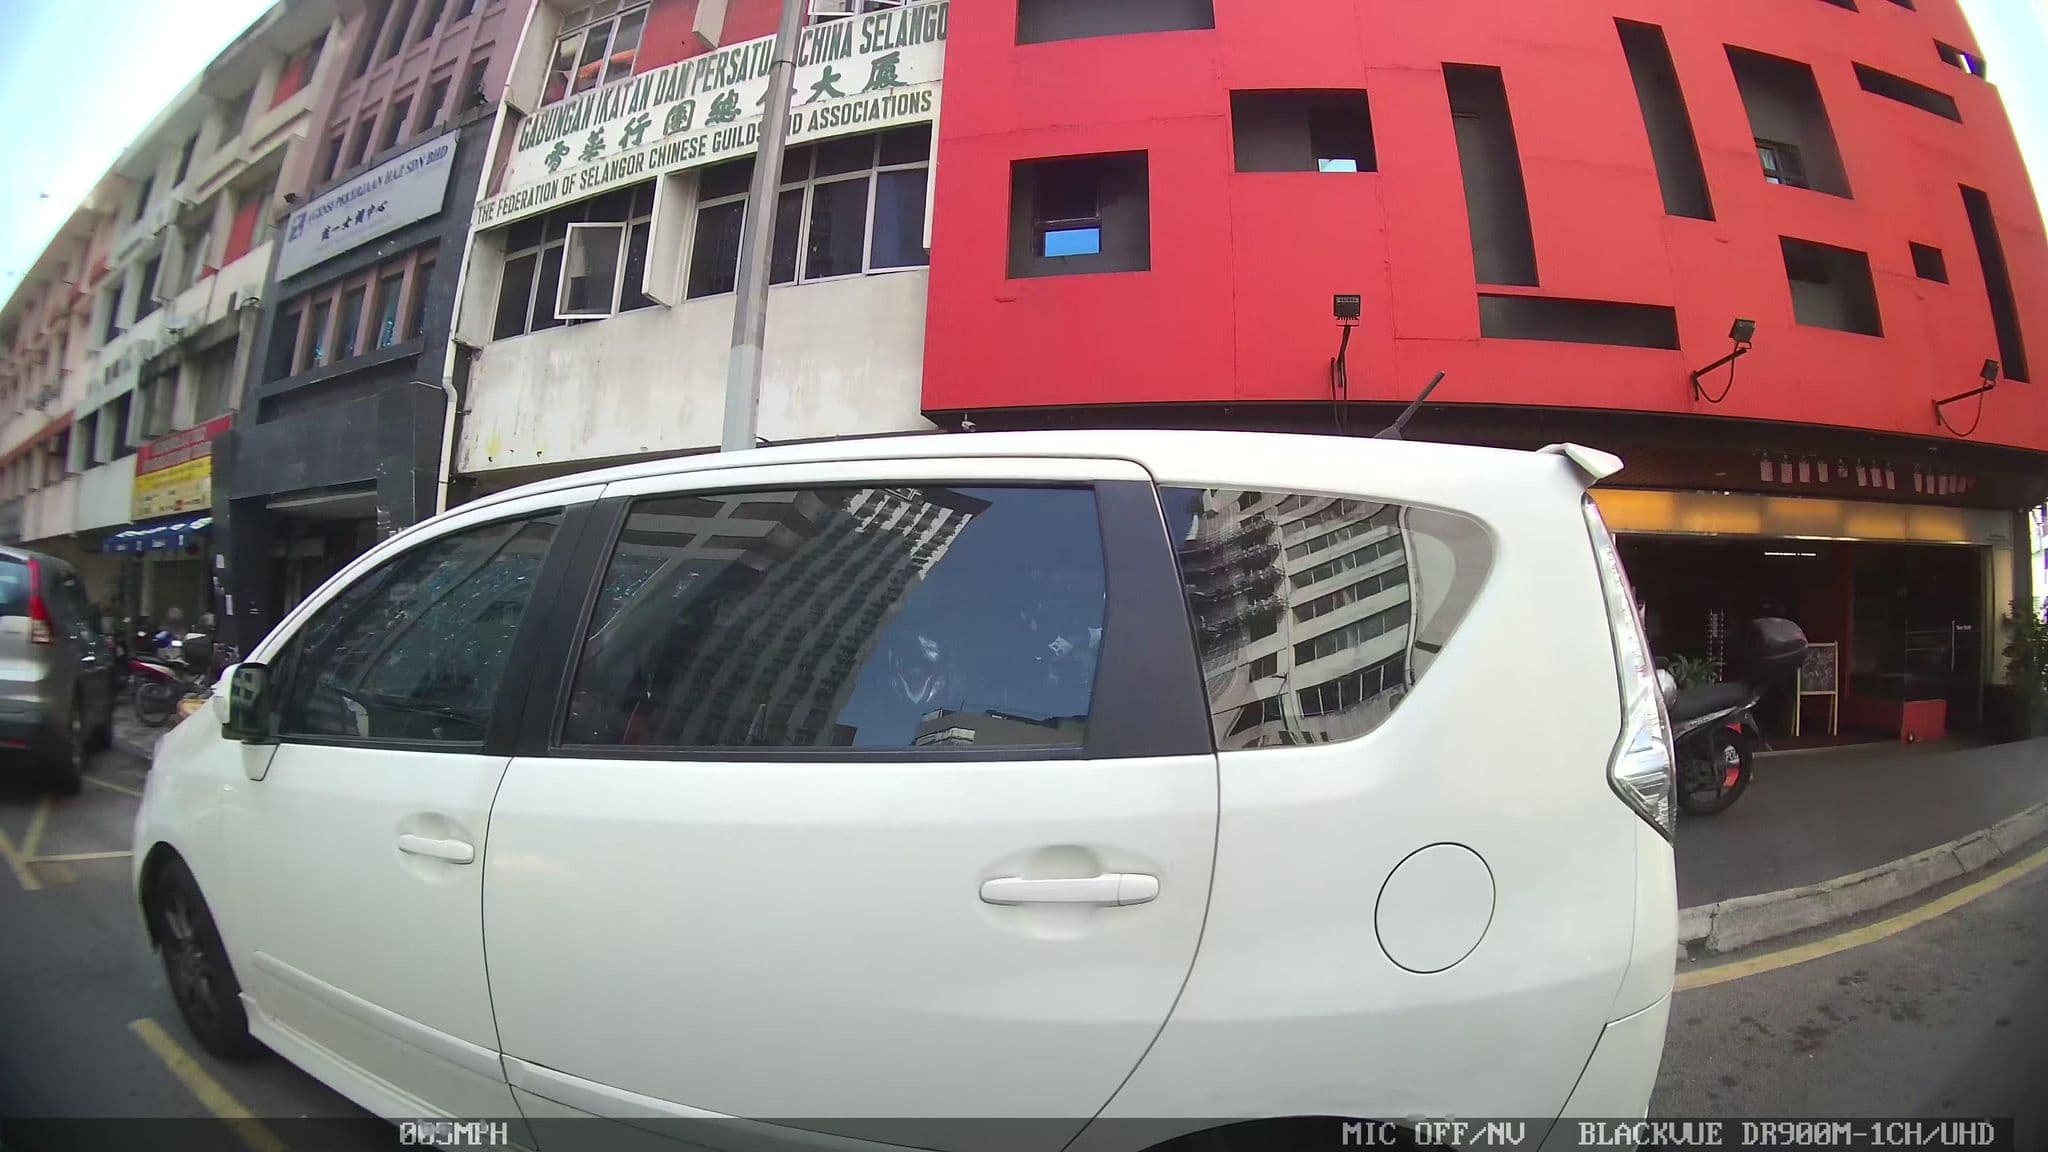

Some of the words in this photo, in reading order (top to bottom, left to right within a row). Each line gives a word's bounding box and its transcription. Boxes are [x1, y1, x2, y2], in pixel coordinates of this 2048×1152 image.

[518, 92, 597, 152] GABUNGAN
[592, 73, 653, 126] IKATAN
[653, 60, 693, 106] DAN
[690, 39, 774, 95] PERSATU
[798, 20, 853, 67] CHINA
[807, 90, 932, 132] ASSOCIATIONS
[476, 203, 495, 225] THE
[496, 181, 558, 217] FEDERATION
[561, 172, 577, 196] OF
[579, 151, 645, 190] SELANGOR
[649, 134, 708, 170] CHINESE
